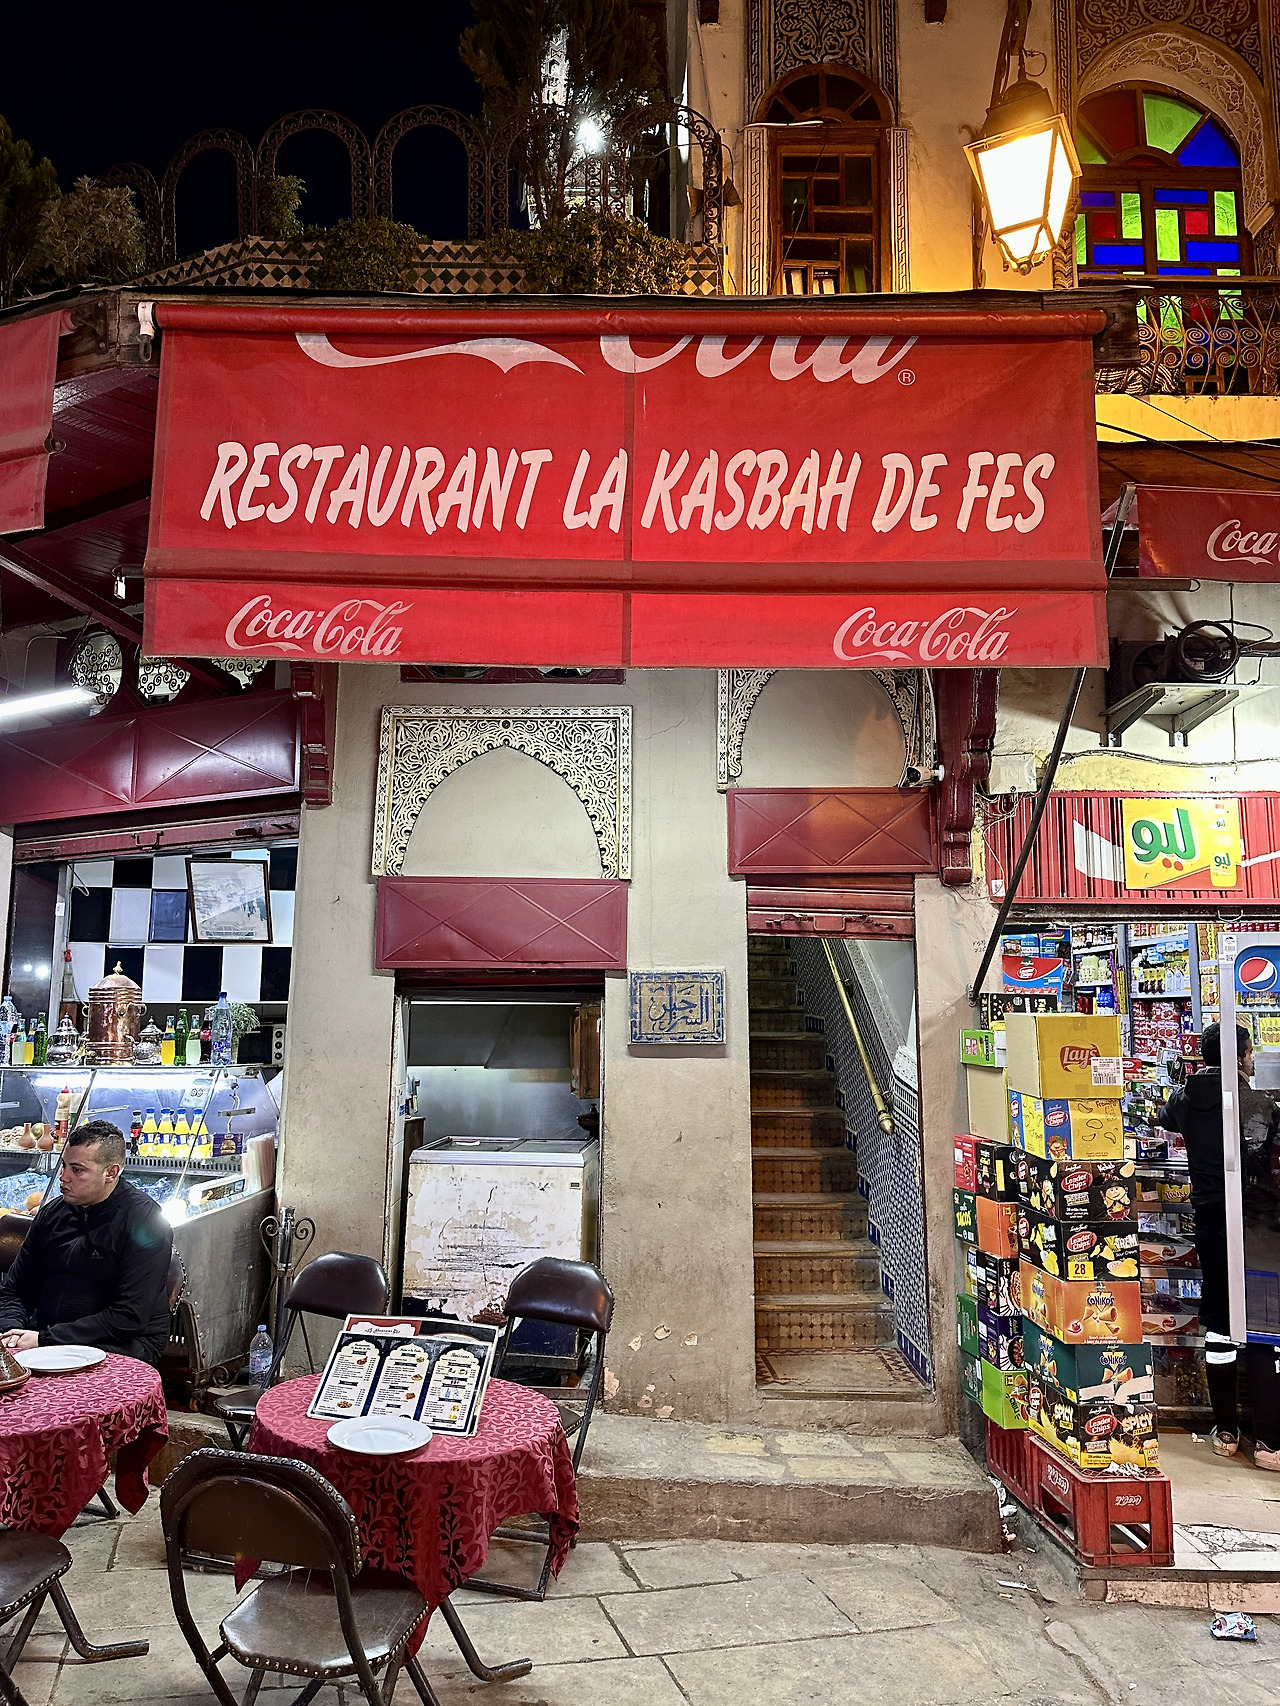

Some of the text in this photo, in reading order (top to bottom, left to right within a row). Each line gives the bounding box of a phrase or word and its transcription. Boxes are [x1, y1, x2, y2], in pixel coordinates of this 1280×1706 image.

[200, 441, 1056, 535] RESTAURANT LA KASBAH DE FES
[1206, 519, 1280, 565] Coca
[225, 595, 415, 657] Coca-Cola
[833, 606, 1019, 662] Coca-Cola
[1131, 807, 1197, 872] ليو
[1065, 1174, 1087, 1185] Leader
[1068, 1181, 1087, 1190] Chips
[1070, 1234, 1090, 1245] Leader
[1072, 1240, 1090, 1250] Chips
[1074, 1263, 1086, 1275] 28
[1089, 1418, 1110, 1429] Leader
[1122, 1412, 1153, 1432] SPICY
[1092, 1424, 1111, 1434] Chips
